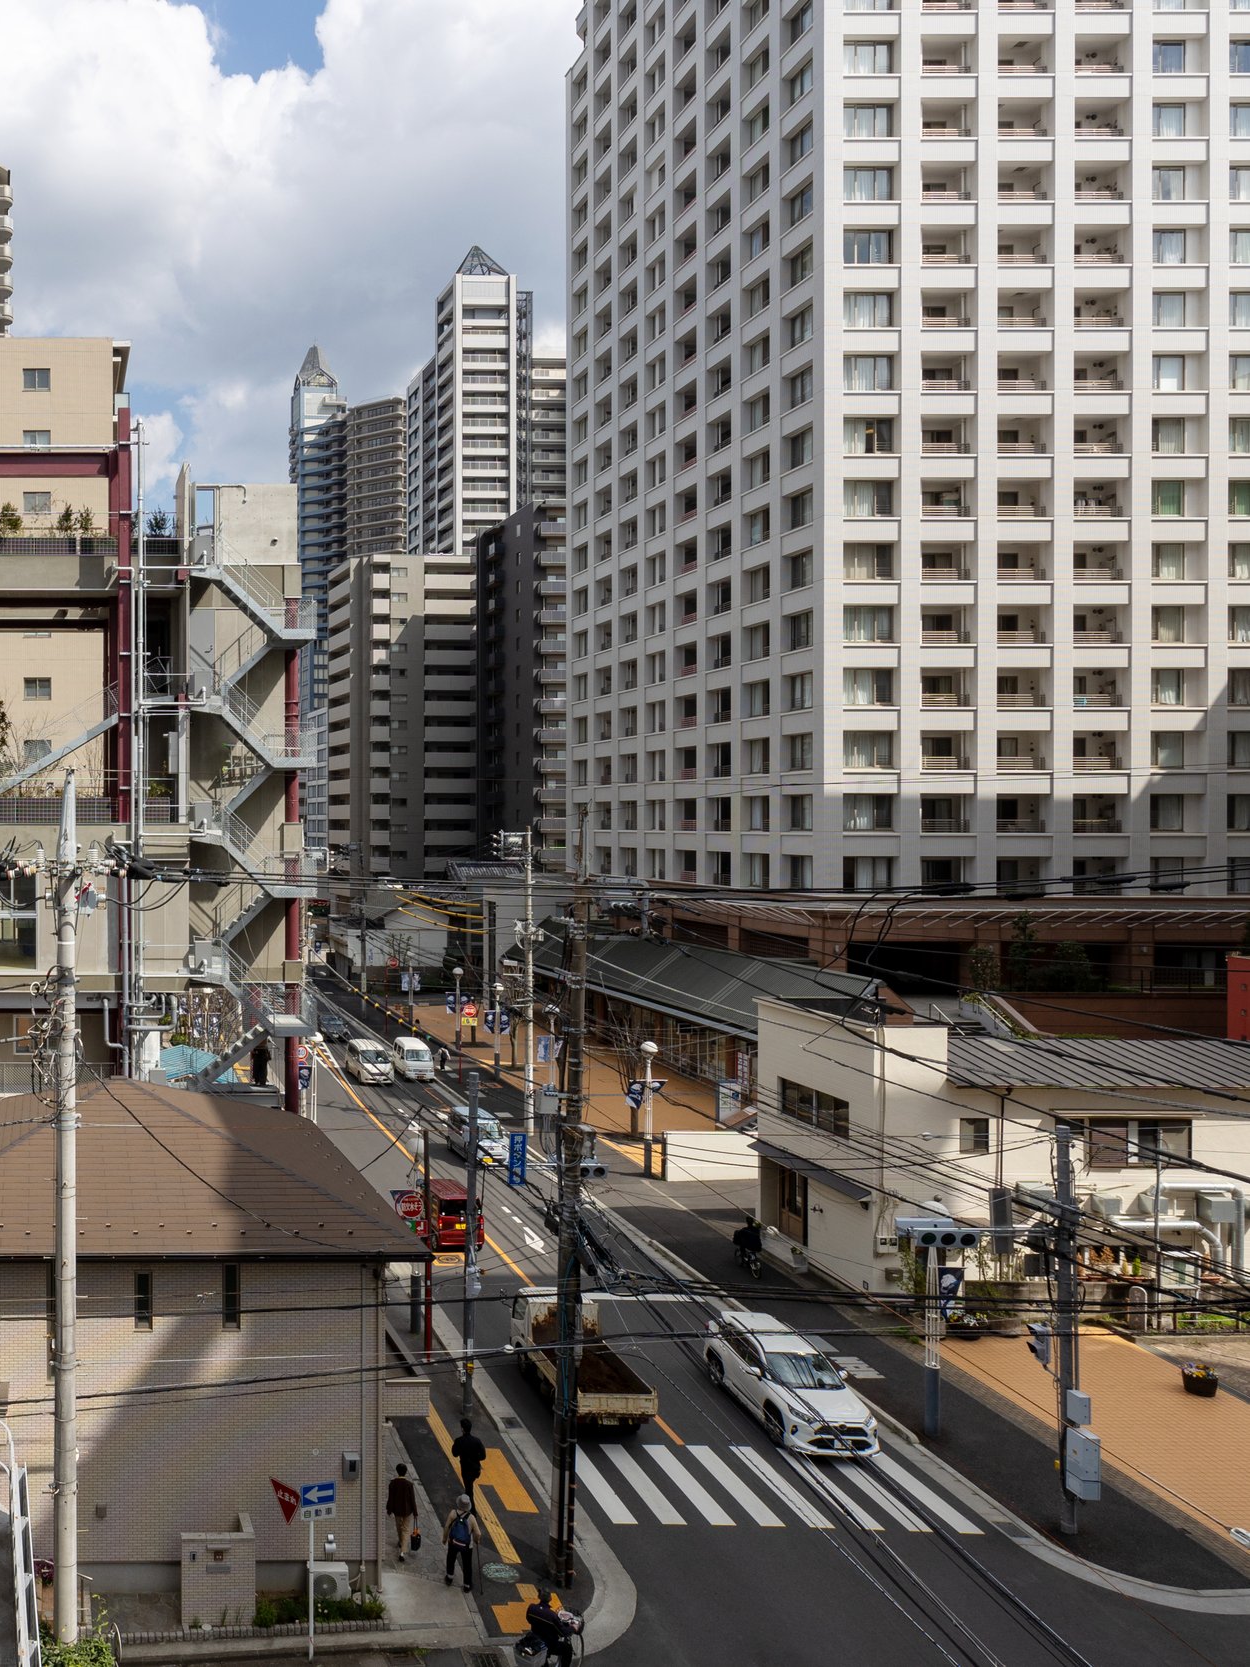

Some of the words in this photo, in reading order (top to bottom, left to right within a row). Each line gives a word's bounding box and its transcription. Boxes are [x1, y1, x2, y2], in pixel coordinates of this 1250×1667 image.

[277, 1489, 297, 1506] 止まれ
[304, 1507, 332, 1519] 自動車
